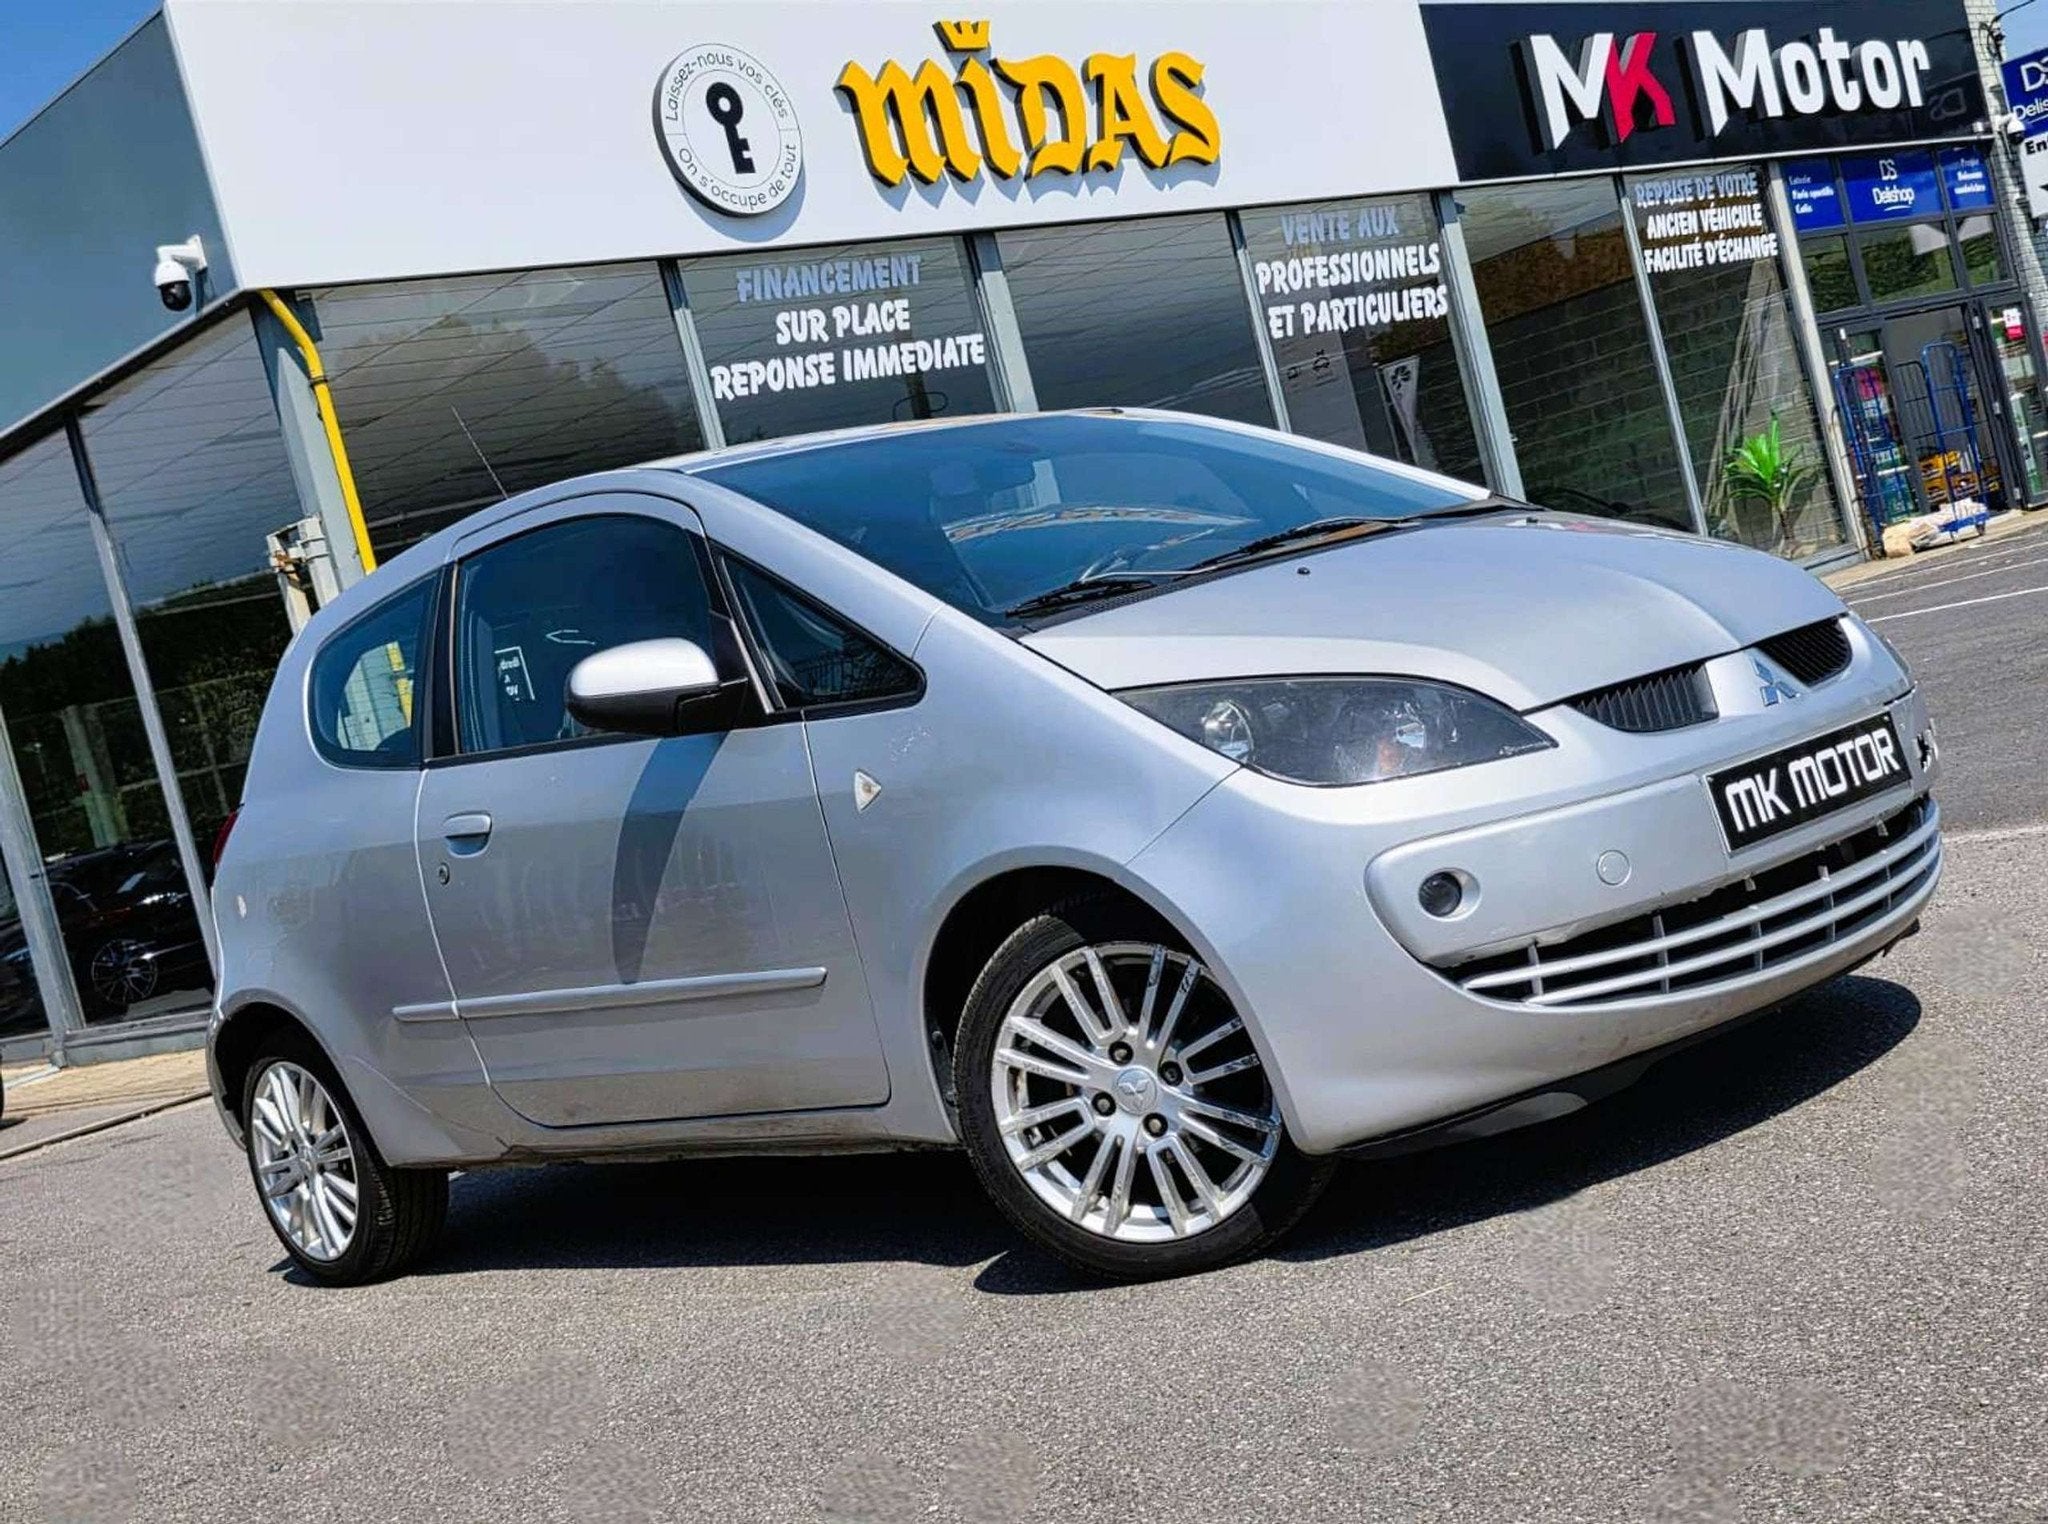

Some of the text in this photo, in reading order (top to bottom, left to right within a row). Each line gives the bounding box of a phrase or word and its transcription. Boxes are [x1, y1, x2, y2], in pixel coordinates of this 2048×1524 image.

[666, 53, 788, 121] Laissez-nous vos clés
[1526, 27, 1931, 150] MK Motor
[678, 144, 796, 211] On s'occupe de tout
[1635, 172, 1758, 208] REPRISE DE VOTRE
[1280, 205, 1399, 245] VENTE AUX
[1647, 202, 1762, 239] ANCIEN VÉHICULE
[736, 255, 921, 302] FINANCEMENT
[1255, 243, 1440, 295] PROFESSIONNELS
[1644, 233, 1778, 273] FACILITÉ D'ÉCHANGE
[776, 299, 910, 345] SUR PLACE
[1268, 285, 1448, 339] ET PARTICULIERS
[710, 333, 985, 401] REPONSE IMMEDIATE
[1725, 727, 1901, 832] MK MOTOR
